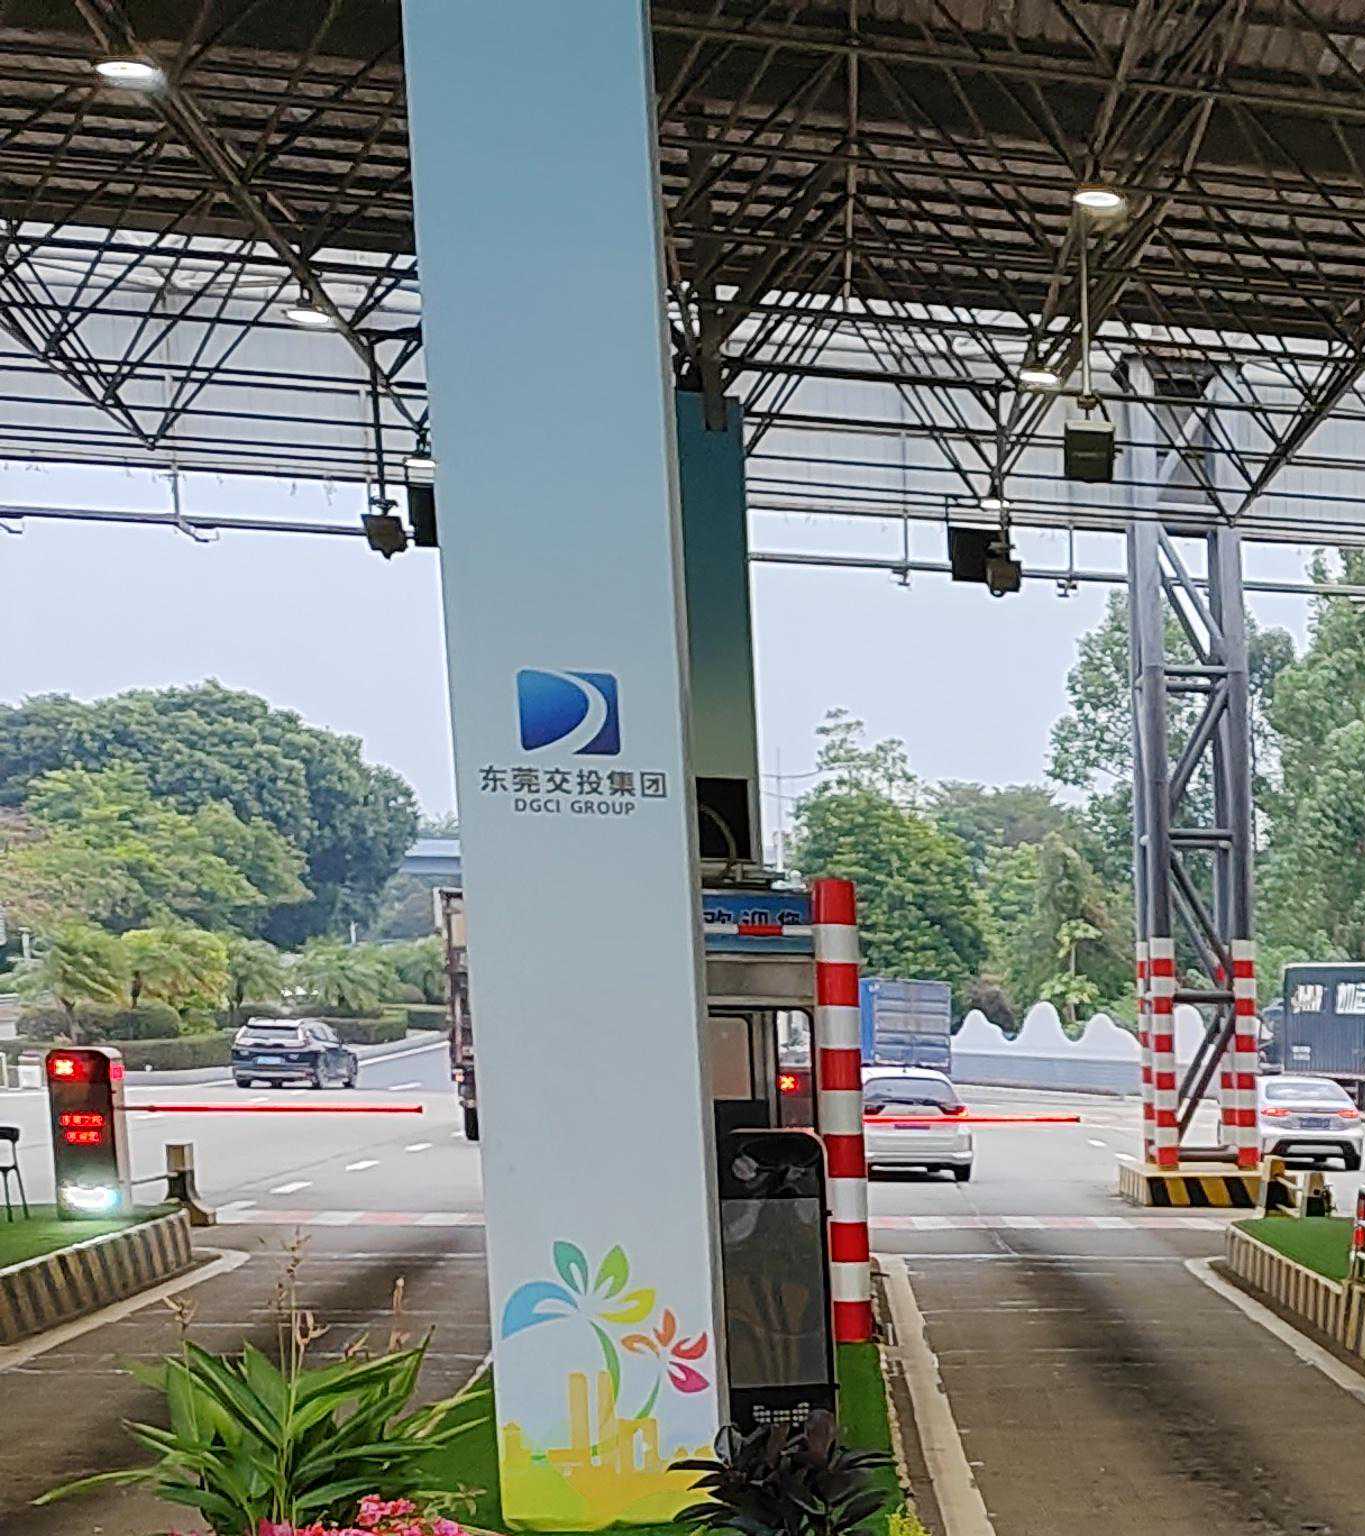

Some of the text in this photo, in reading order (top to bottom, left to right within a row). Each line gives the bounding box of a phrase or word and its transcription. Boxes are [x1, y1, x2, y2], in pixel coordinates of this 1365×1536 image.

[479, 765, 668, 798] 东莞交投集团
[514, 799, 636, 815] DGCI GROUP
